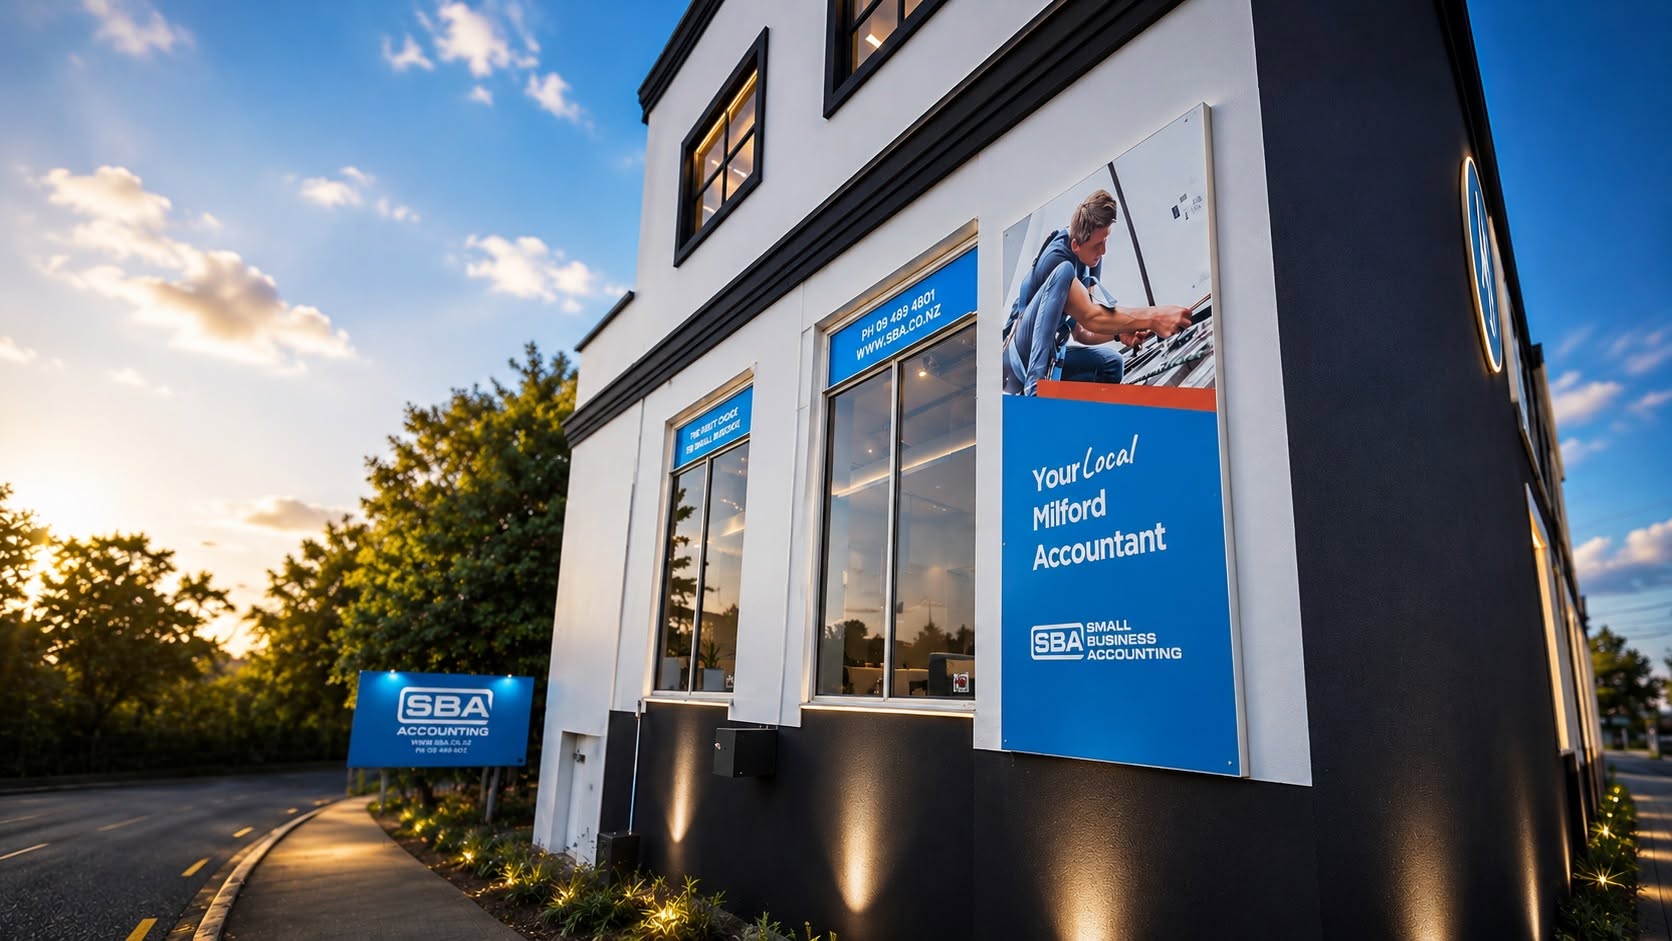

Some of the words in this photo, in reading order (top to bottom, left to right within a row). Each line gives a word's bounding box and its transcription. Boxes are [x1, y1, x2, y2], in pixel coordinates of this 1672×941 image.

[856, 303, 942, 361] WWW.SBA.CO.NZ
[861, 324, 875, 342] PH
[876, 316, 888, 333] 09
[890, 304, 909, 324] 489
[1032, 461, 1081, 492] Your
[1083, 433, 1139, 479] Local
[1033, 488, 1106, 531] Milford
[1032, 521, 1167, 571] Accountant
[1086, 619, 1132, 633] SMALL
[1034, 631, 1084, 653] SBA
[1087, 632, 1157, 647] BUSINESS
[1087, 647, 1183, 661] ACCOUNTING
[406, 695, 489, 718] SBA
[396, 726, 489, 737] ACCOUNTING
